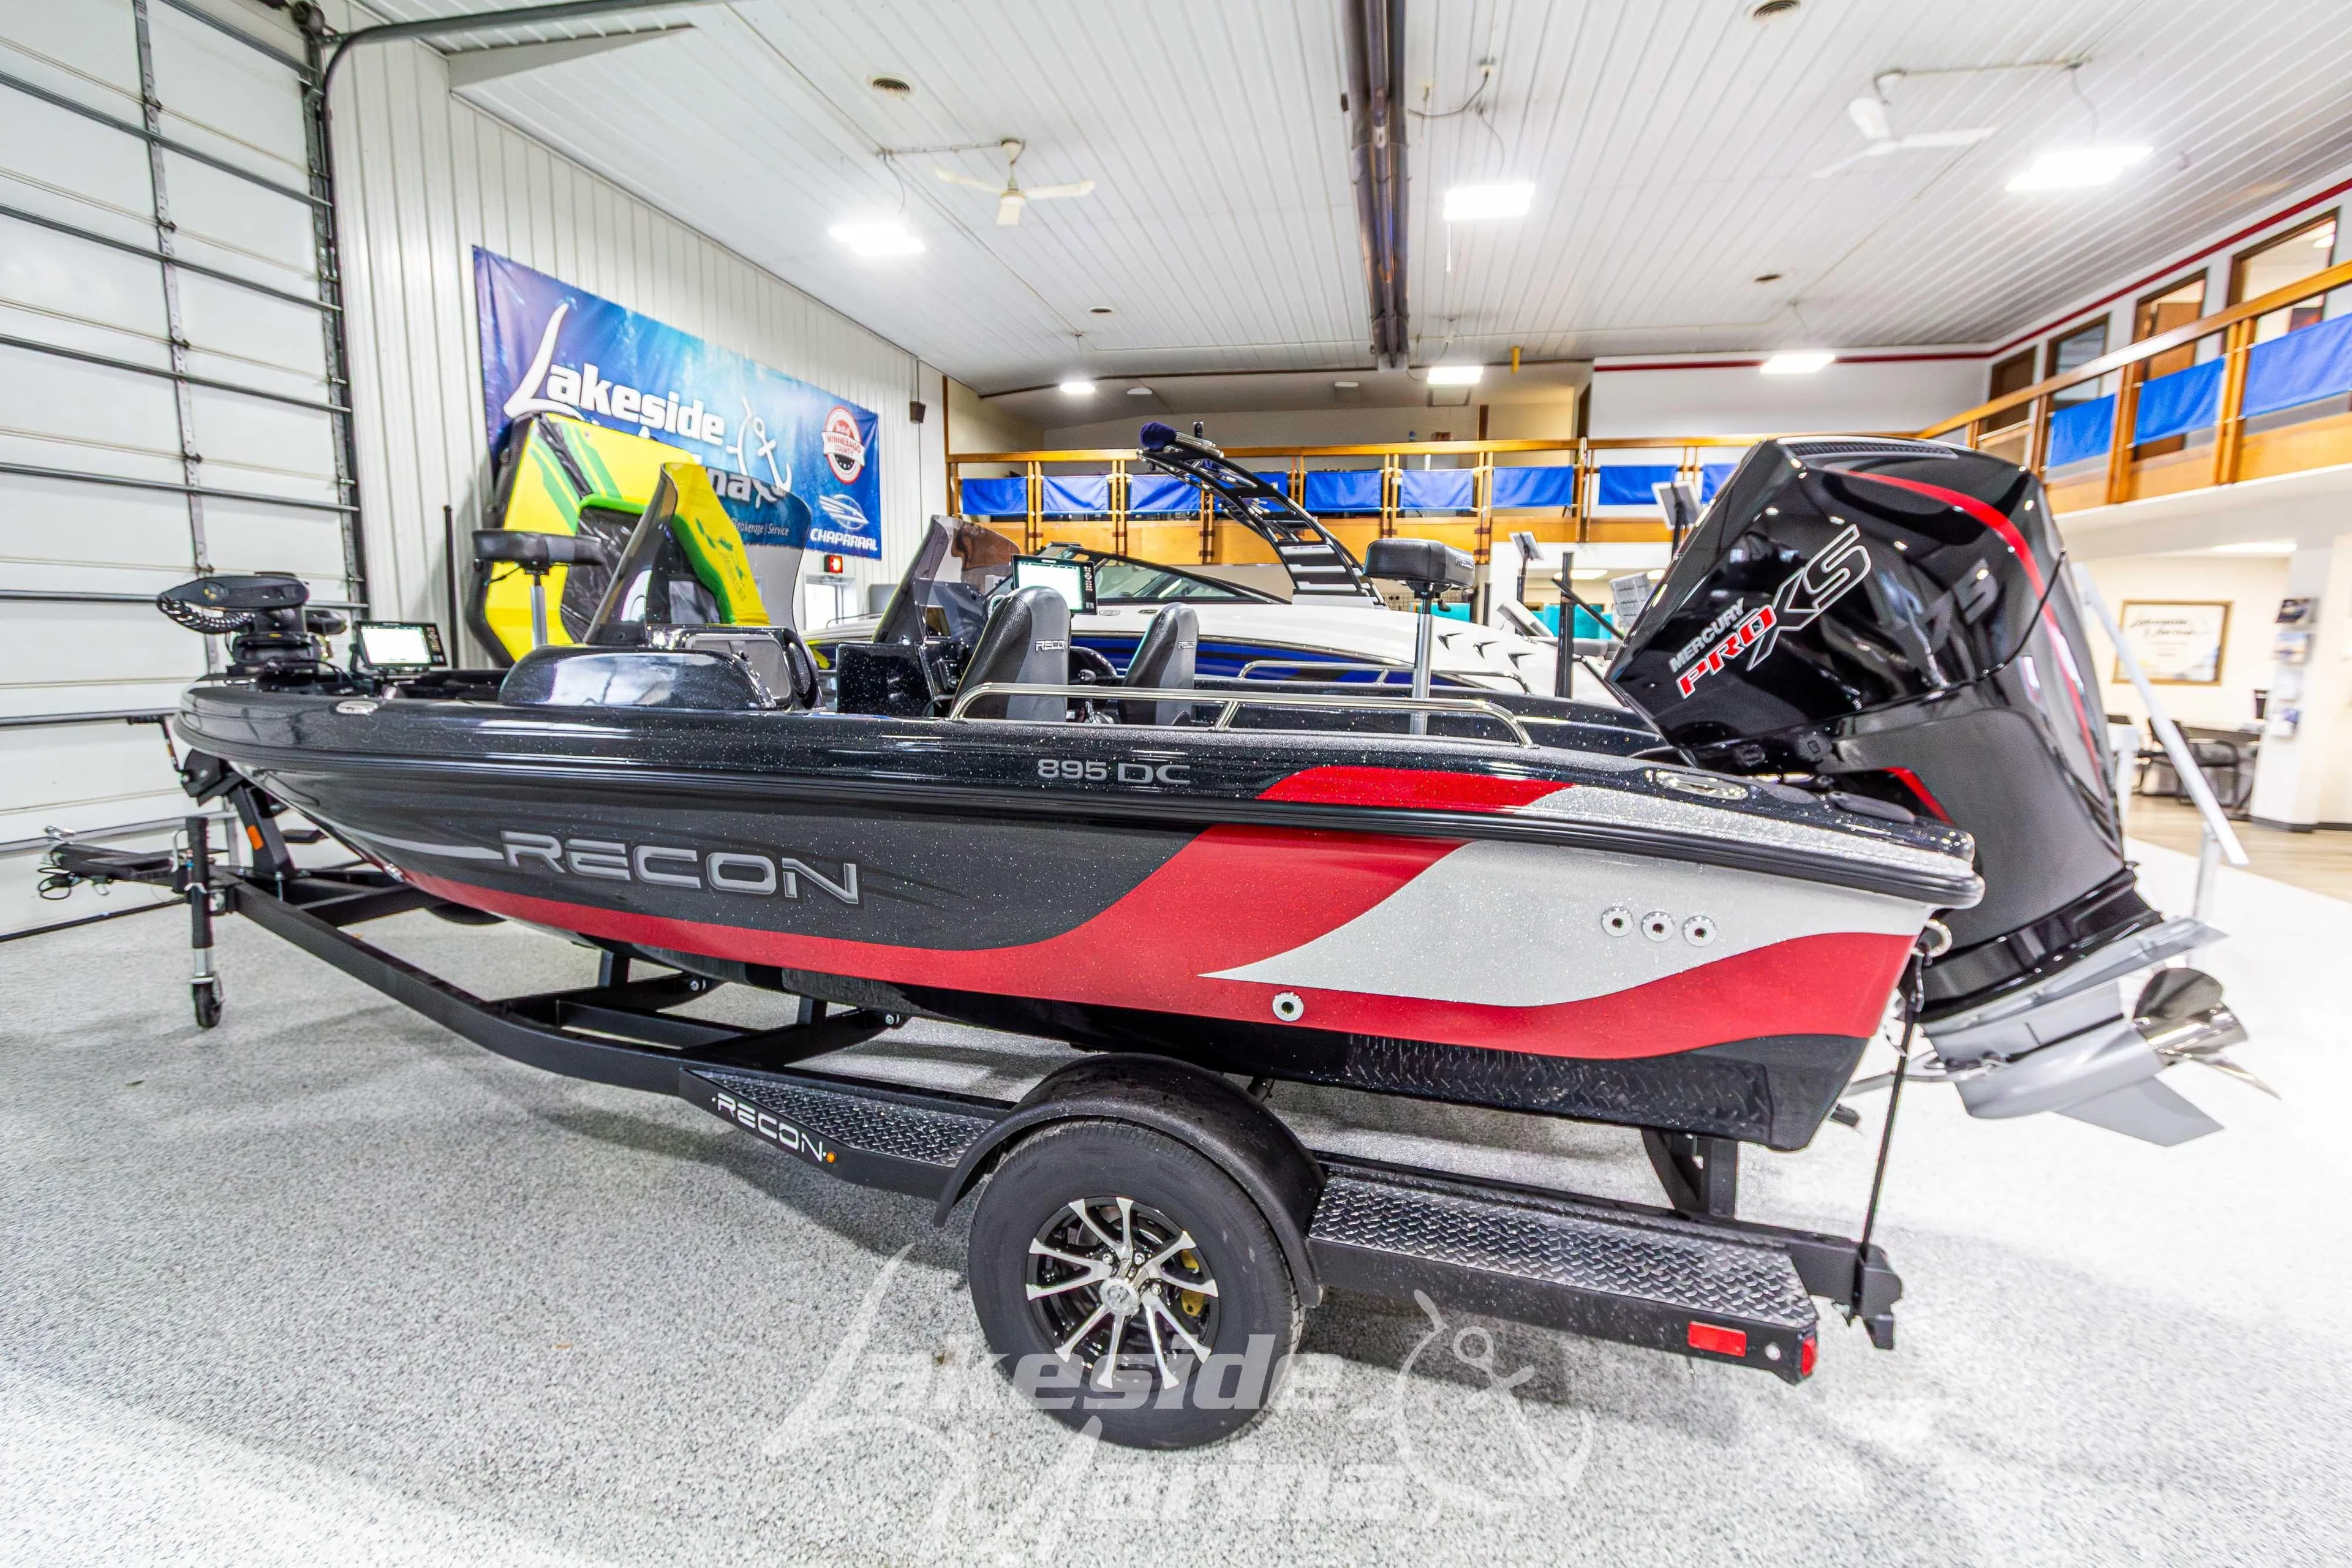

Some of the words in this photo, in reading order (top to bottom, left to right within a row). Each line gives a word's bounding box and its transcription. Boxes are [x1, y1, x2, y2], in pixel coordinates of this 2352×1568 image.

[503, 303, 725, 447] Lakeside
[767, 523, 790, 536] Service
[810, 528, 878, 551] CHAPARRAL
[1668, 597, 1744, 673] MERCURY
[1676, 605, 1777, 699] PRO
[1038, 759, 1107, 781] 895
[1118, 763, 1191, 785] DC
[500, 830, 859, 905] RECON
[717, 1092, 823, 1162] RECON
